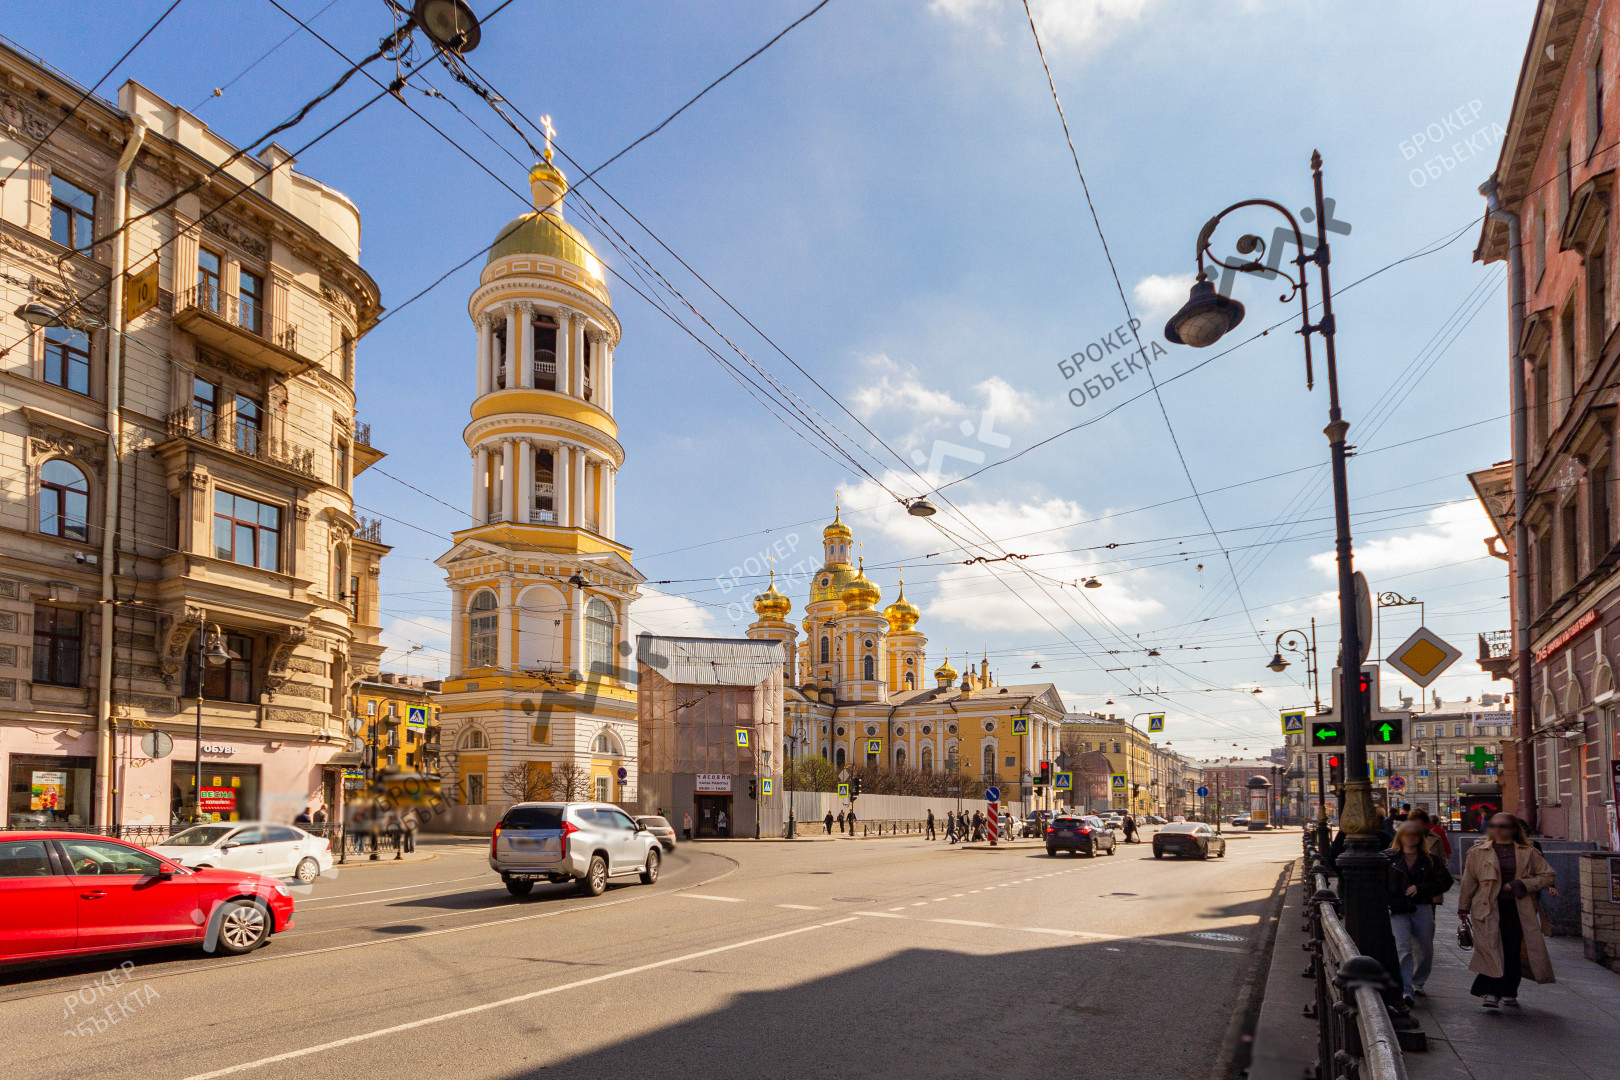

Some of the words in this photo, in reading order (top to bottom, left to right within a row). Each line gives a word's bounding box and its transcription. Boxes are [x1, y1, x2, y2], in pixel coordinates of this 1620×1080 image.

[138, 283, 148, 303] 10
[204, 745, 239, 754] ОБУВЬ
[201, 790, 235, 799] ВЕСНА
